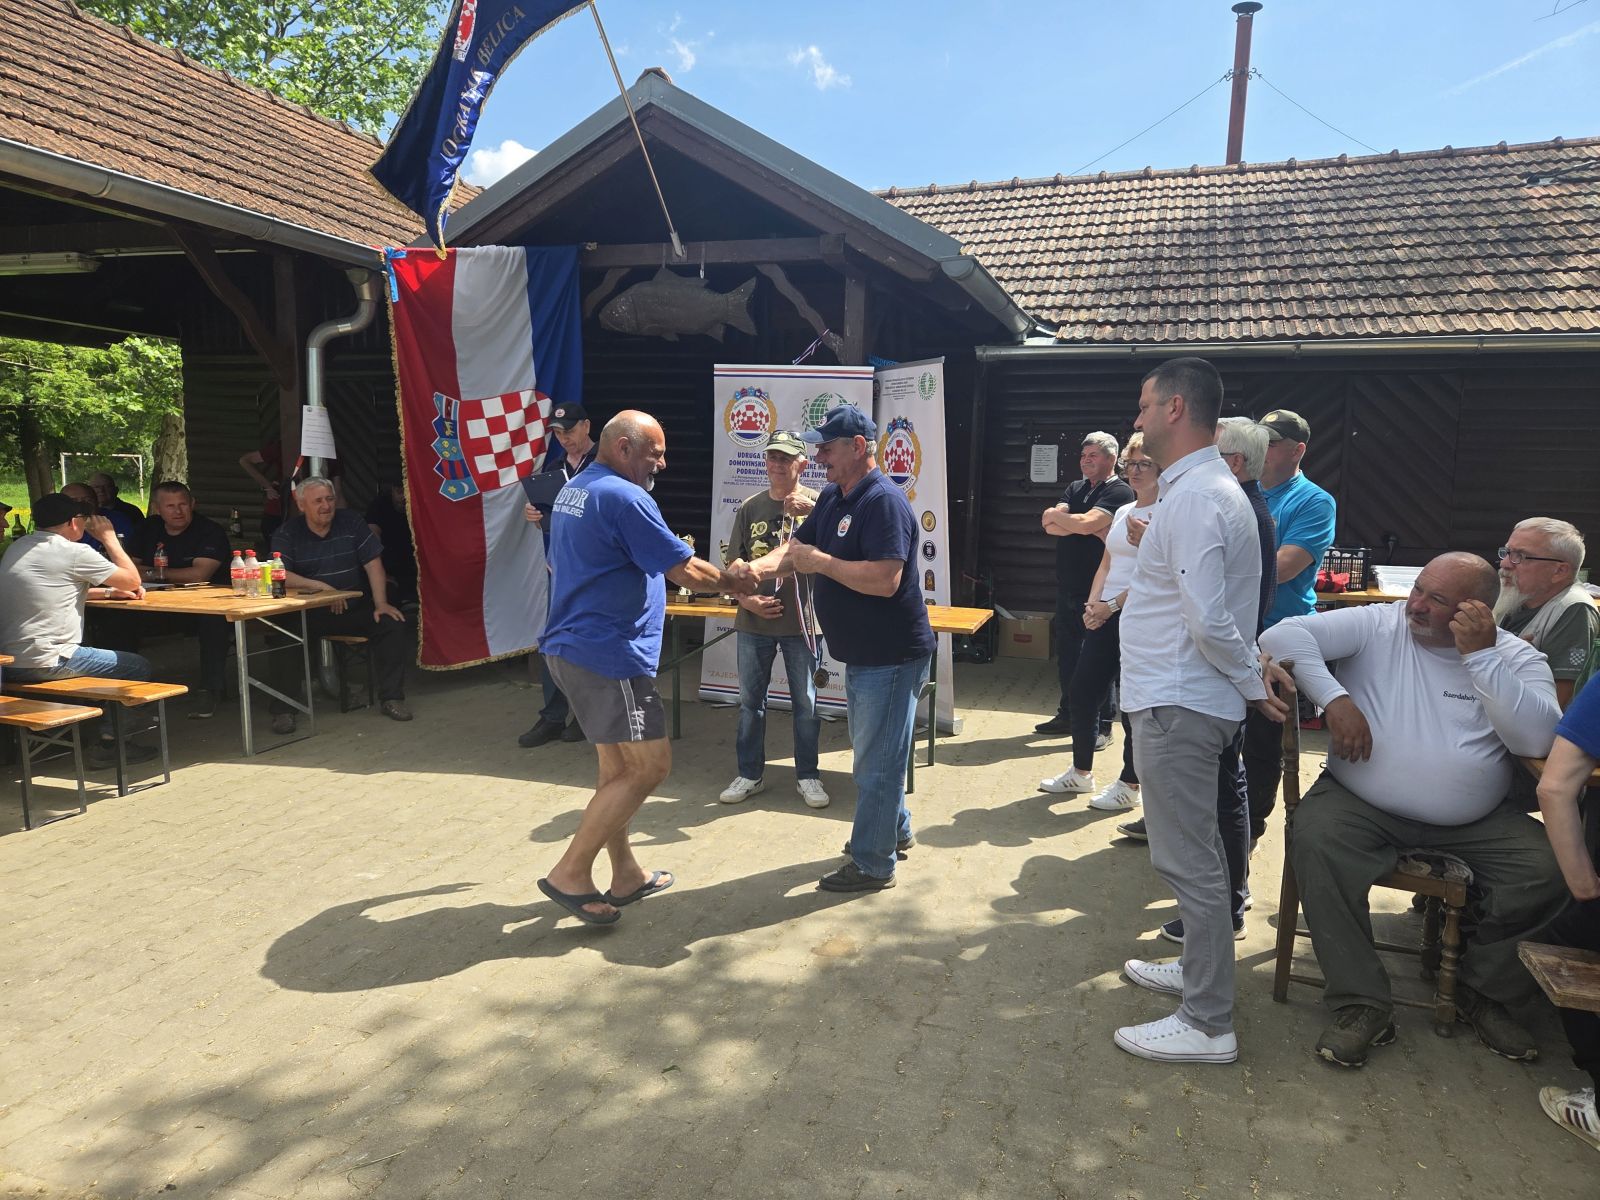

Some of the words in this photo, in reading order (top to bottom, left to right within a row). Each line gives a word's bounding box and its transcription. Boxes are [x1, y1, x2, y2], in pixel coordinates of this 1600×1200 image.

[477, 5, 526, 67] BELICA
[729, 460, 767, 468] DOMOVINSKO
[736, 468, 768, 476] PODRUŽNIC
